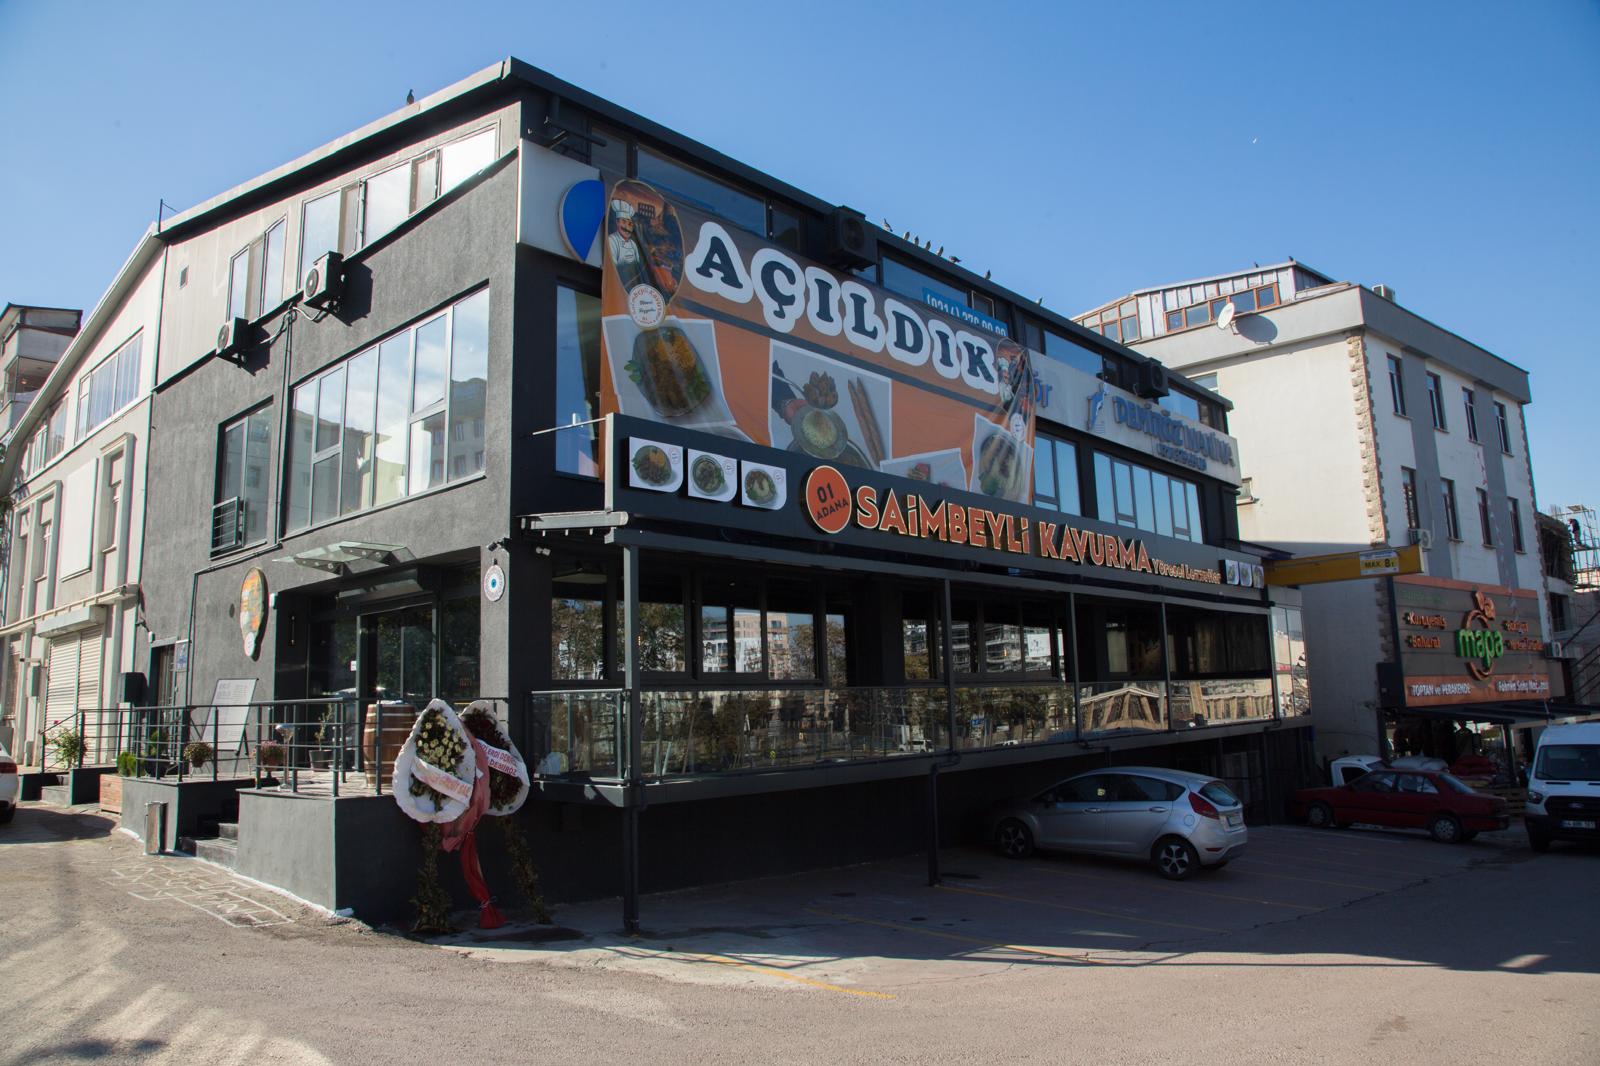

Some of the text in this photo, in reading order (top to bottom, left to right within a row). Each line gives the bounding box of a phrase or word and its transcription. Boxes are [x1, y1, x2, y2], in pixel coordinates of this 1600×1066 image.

[690, 229, 998, 389] AÇILDIK
[816, 482, 834, 503] 01
[816, 498, 849, 521] ADANA
[1038, 520, 1152, 574] KAVURMA
[1457, 629, 1504, 672] mapa
